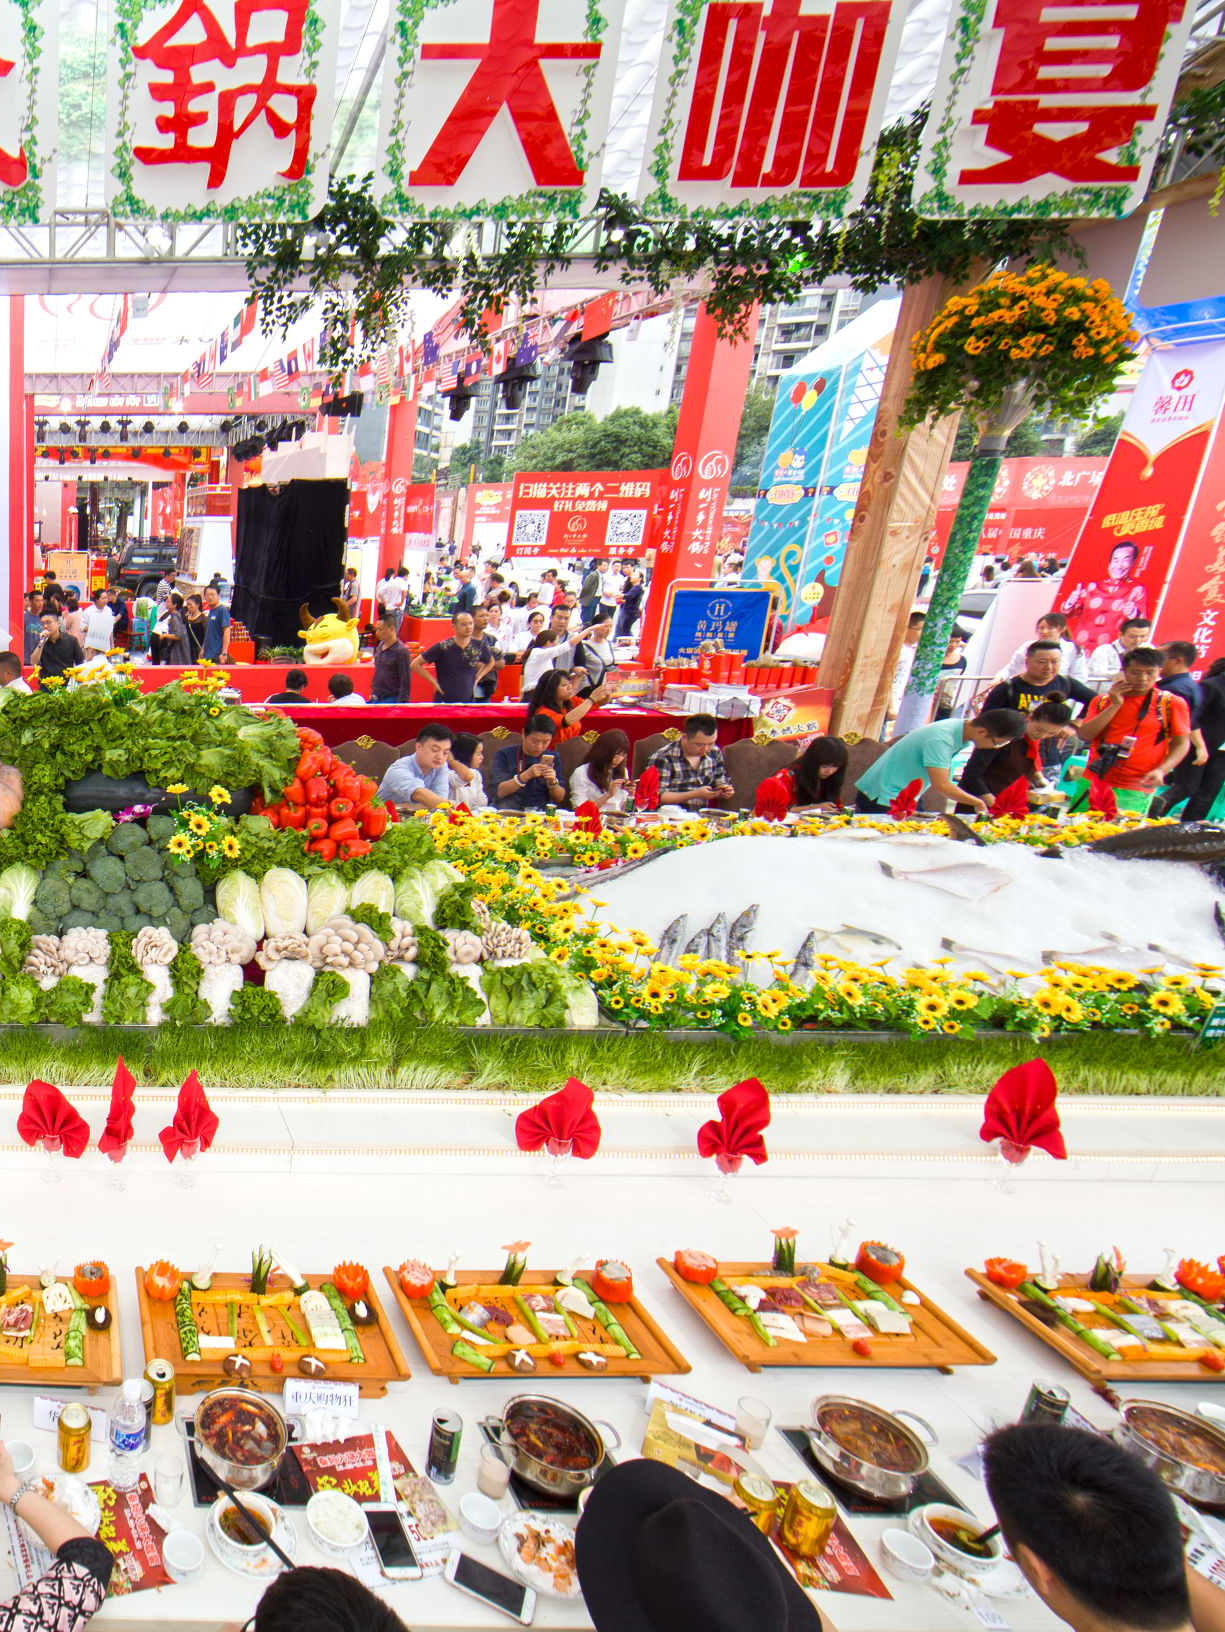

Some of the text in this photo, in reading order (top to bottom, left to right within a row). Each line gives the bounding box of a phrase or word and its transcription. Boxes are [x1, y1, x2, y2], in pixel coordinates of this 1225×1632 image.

[518, 482, 651, 498] 扫描关注两个二维码
[553, 500, 608, 512] 好礼免费领
[290, 1391, 355, 1408] 重庆购物狂
